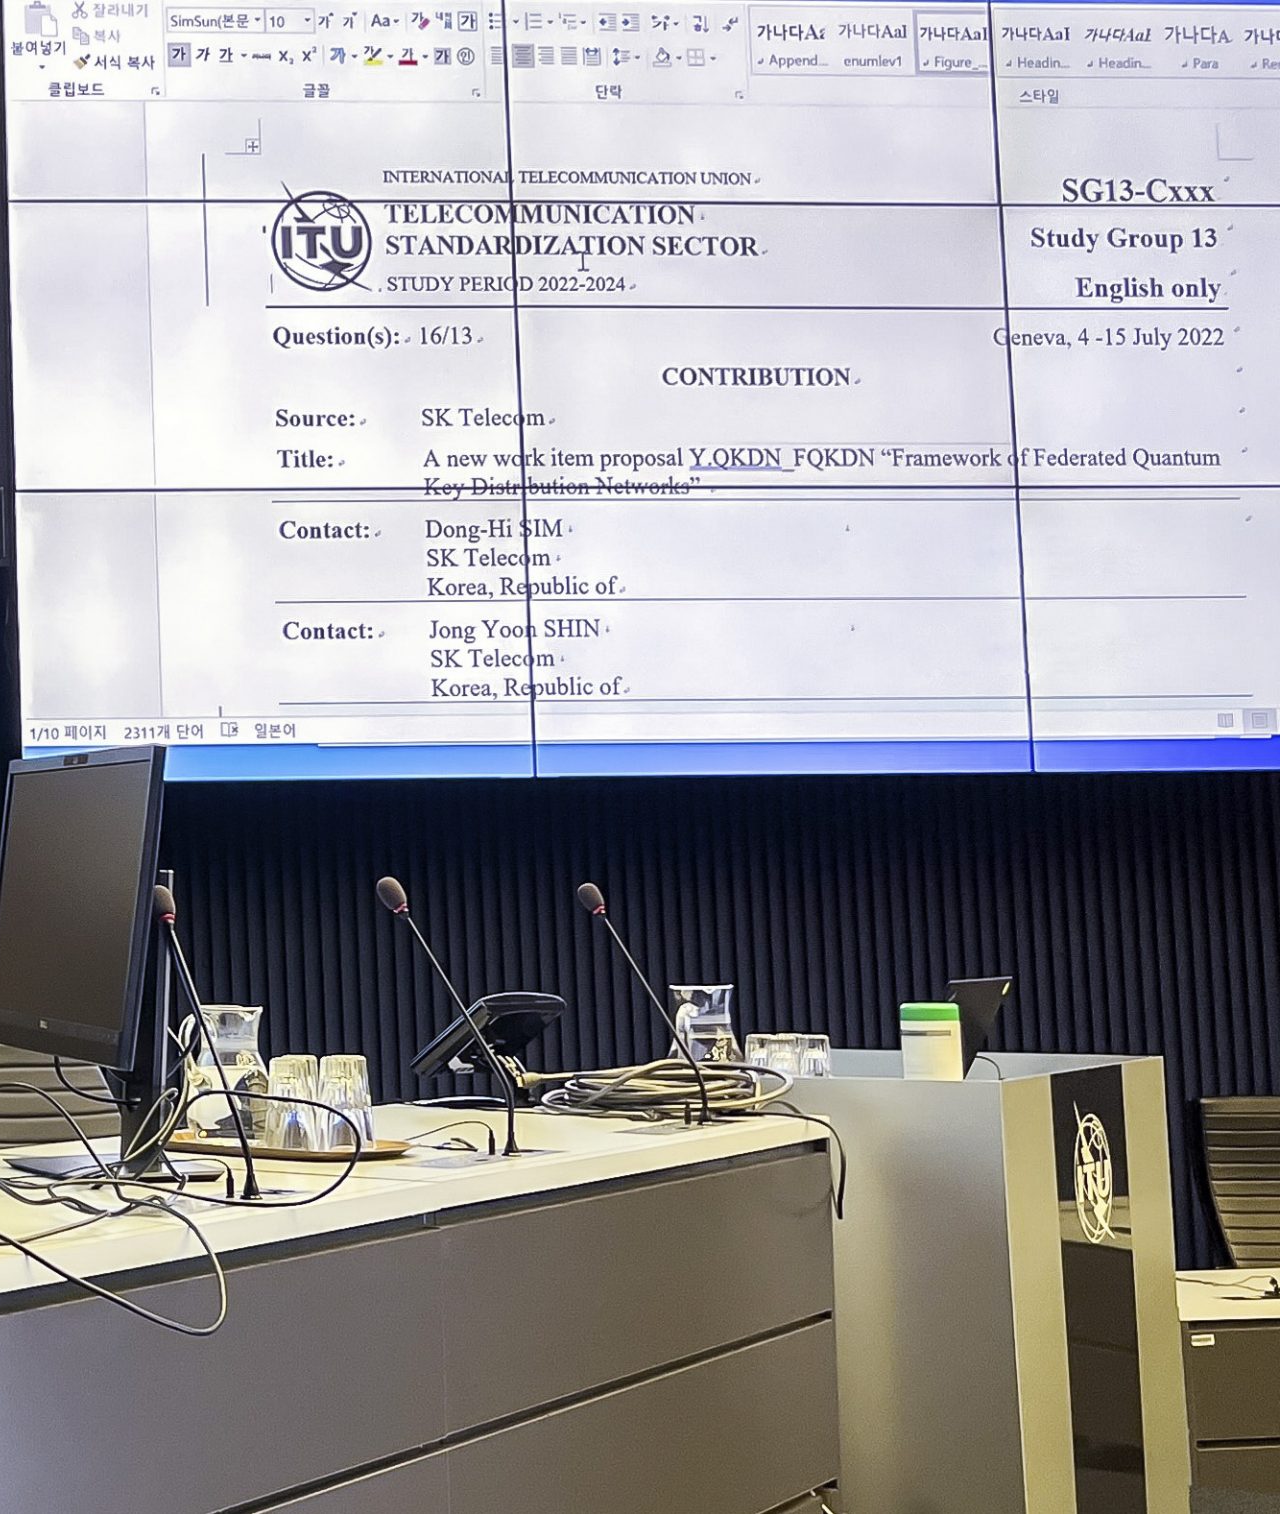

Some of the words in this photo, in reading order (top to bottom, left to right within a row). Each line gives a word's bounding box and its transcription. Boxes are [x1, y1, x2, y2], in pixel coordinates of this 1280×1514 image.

[93, 3, 148, 18] 잘라내기
[270, 16, 285, 28] 10
[371, 14, 390, 27] Aa
[94, 29, 120, 43] 복사
[12, 41, 66, 55] 붙여넣기
[94, 55, 121, 70] 서식
[127, 55, 155, 70] 복사
[844, 55, 902, 68] enumlev1
[1193, 58, 1219, 69] Para
[48, 82, 104, 97] 클립보드
[303, 83, 330, 98] 글꼴
[595, 84, 622, 99] 단락
[1019, 89, 1059, 104] 스타일
[383, 170, 513, 184] INTERNATIONAL
[518, 171, 696, 185] TELECOMMUNICATION
[700, 172, 751, 185] UNION
[1062, 178, 1216, 204] SG13-Cxxx
[386, 204, 695, 226] TELECOMMUNICATION
[281, 225, 363, 259] ITU
[385, 235, 645, 257] STANDARDIZATION
[651, 236, 759, 257] SECTOR
[1030, 227, 1099, 253] Study
[1106, 227, 1183, 253] Group
[1192, 228, 1218, 248] 13
[387, 275, 454, 293] STUDY
[459, 275, 533, 293] PERIOD
[538, 276, 626, 292] 2022-2024
[1075, 277, 1164, 302] English
[1171, 278, 1222, 304] only
[273, 326, 401, 349] Question(s):
[420, 325, 473, 347] 16/13
[993, 328, 1072, 350] Geneva,
[1077, 328, 1089, 346] 4
[1095, 328, 1127, 346] -15
[1132, 328, 1172, 351] July
[1177, 328, 1225, 346] 2022
[662, 367, 851, 387] CONTRIBUTION
[275, 409, 356, 428] Source:
[421, 408, 453, 427] SK
[458, 408, 545, 427] Telecom
[276, 450, 334, 470] Title:
[423, 450, 441, 468] A
[446, 455, 487, 468] new
[494, 449, 546, 468] work
[551, 449, 594, 468] item
[600, 448, 683, 473] proposal
[881, 447, 1002, 468] “Framework
[1007, 447, 1031, 468] of
[1033, 447, 1126, 468] Federated
[1132, 448, 1221, 471] Quantum
[471, 477, 589, 496] Distrbution
[279, 521, 370, 540] Contact:
[425, 519, 513, 543] Dong-Hi
[518, 519, 563, 539] SIM
[427, 548, 459, 567] SK
[464, 548, 551, 567] Telecom
[427, 577, 495, 600] Korea,
[500, 576, 591, 600] Republic
[596, 576, 619, 596] of
[282, 621, 374, 640] Contact:
[429, 620, 475, 644] Jong
[481, 619, 537, 639] Yoon
[543, 619, 600, 638] SHIN
[430, 649, 462, 668] SK
[467, 649, 555, 668] Telecom
[431, 678, 498, 701] Korea,
[504, 676, 595, 701] Republic
[600, 676, 623, 697] of
[30, 728, 59, 741] 1/10
[64, 724, 107, 741] 페이지
[124, 724, 170, 740] 2311개
[177, 724, 204, 740] 단어
[254, 723, 296, 740] 일본어
[1076, 1159, 1111, 1203] ITU
